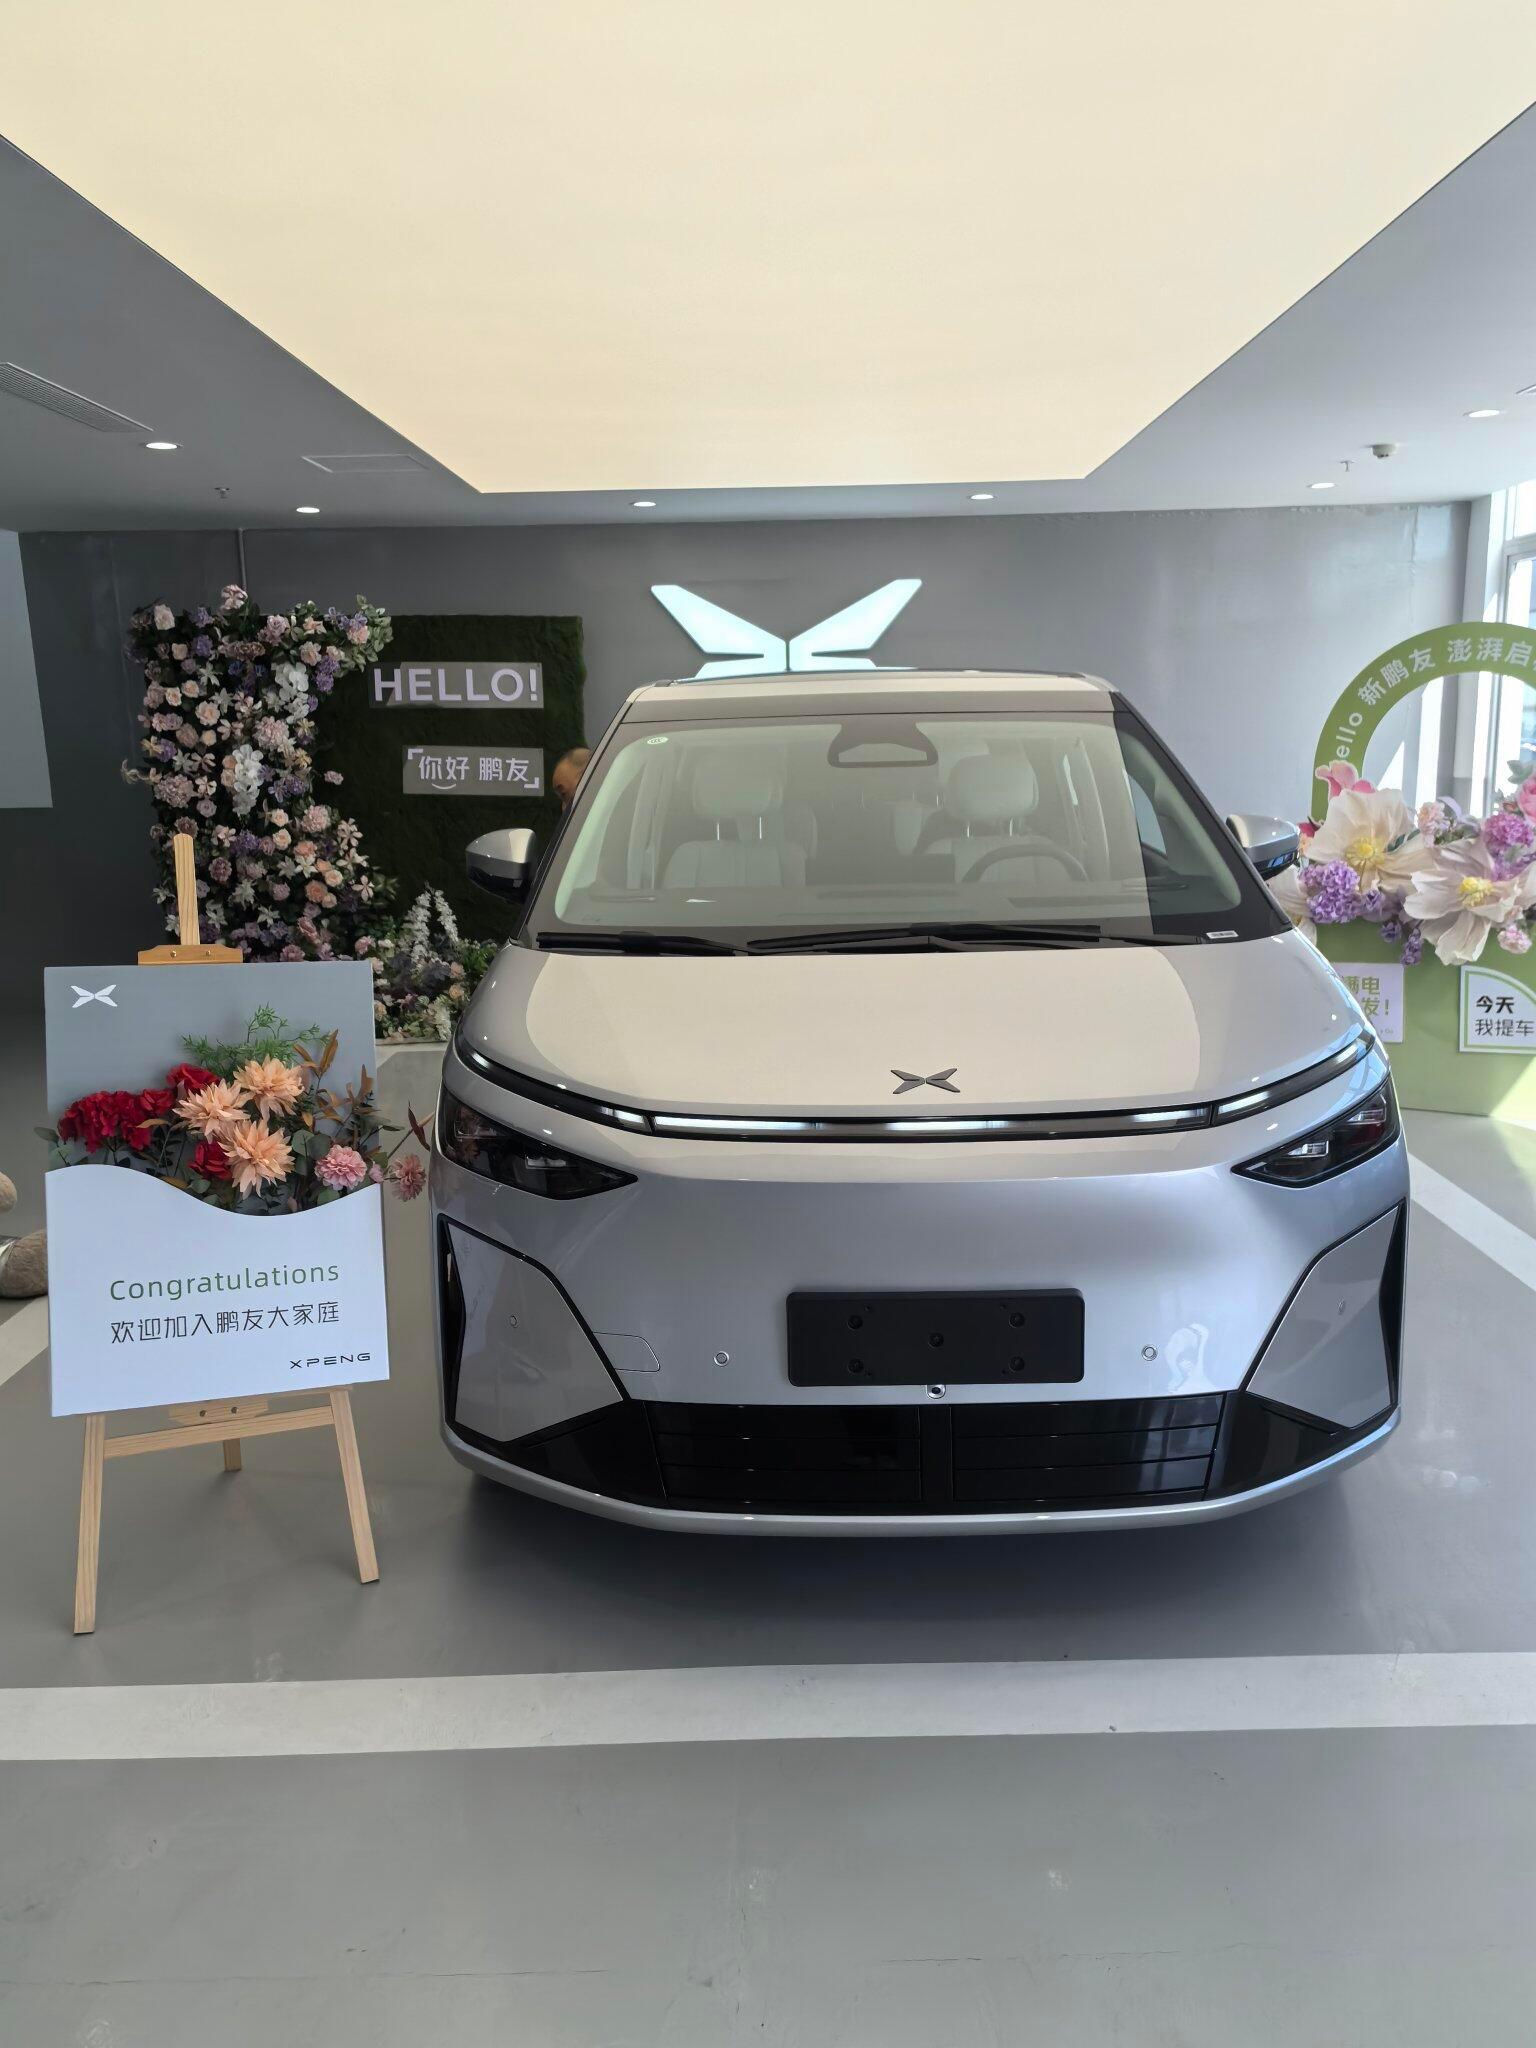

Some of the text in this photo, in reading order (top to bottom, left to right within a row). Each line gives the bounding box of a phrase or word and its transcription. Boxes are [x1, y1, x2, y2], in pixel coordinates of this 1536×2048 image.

[374, 668, 538, 702] HELLO!
[1336, 637, 1536, 758] ello 新鹏友 澎湃启
[1476, 995, 1515, 1014] 今天
[1475, 1018, 1536, 1037] 我提车
[110, 1262, 340, 1301] Congratulations
[110, 1301, 340, 1344] 欢迎加入鹏友大家庭
[289, 1352, 371, 1370] XPENG
